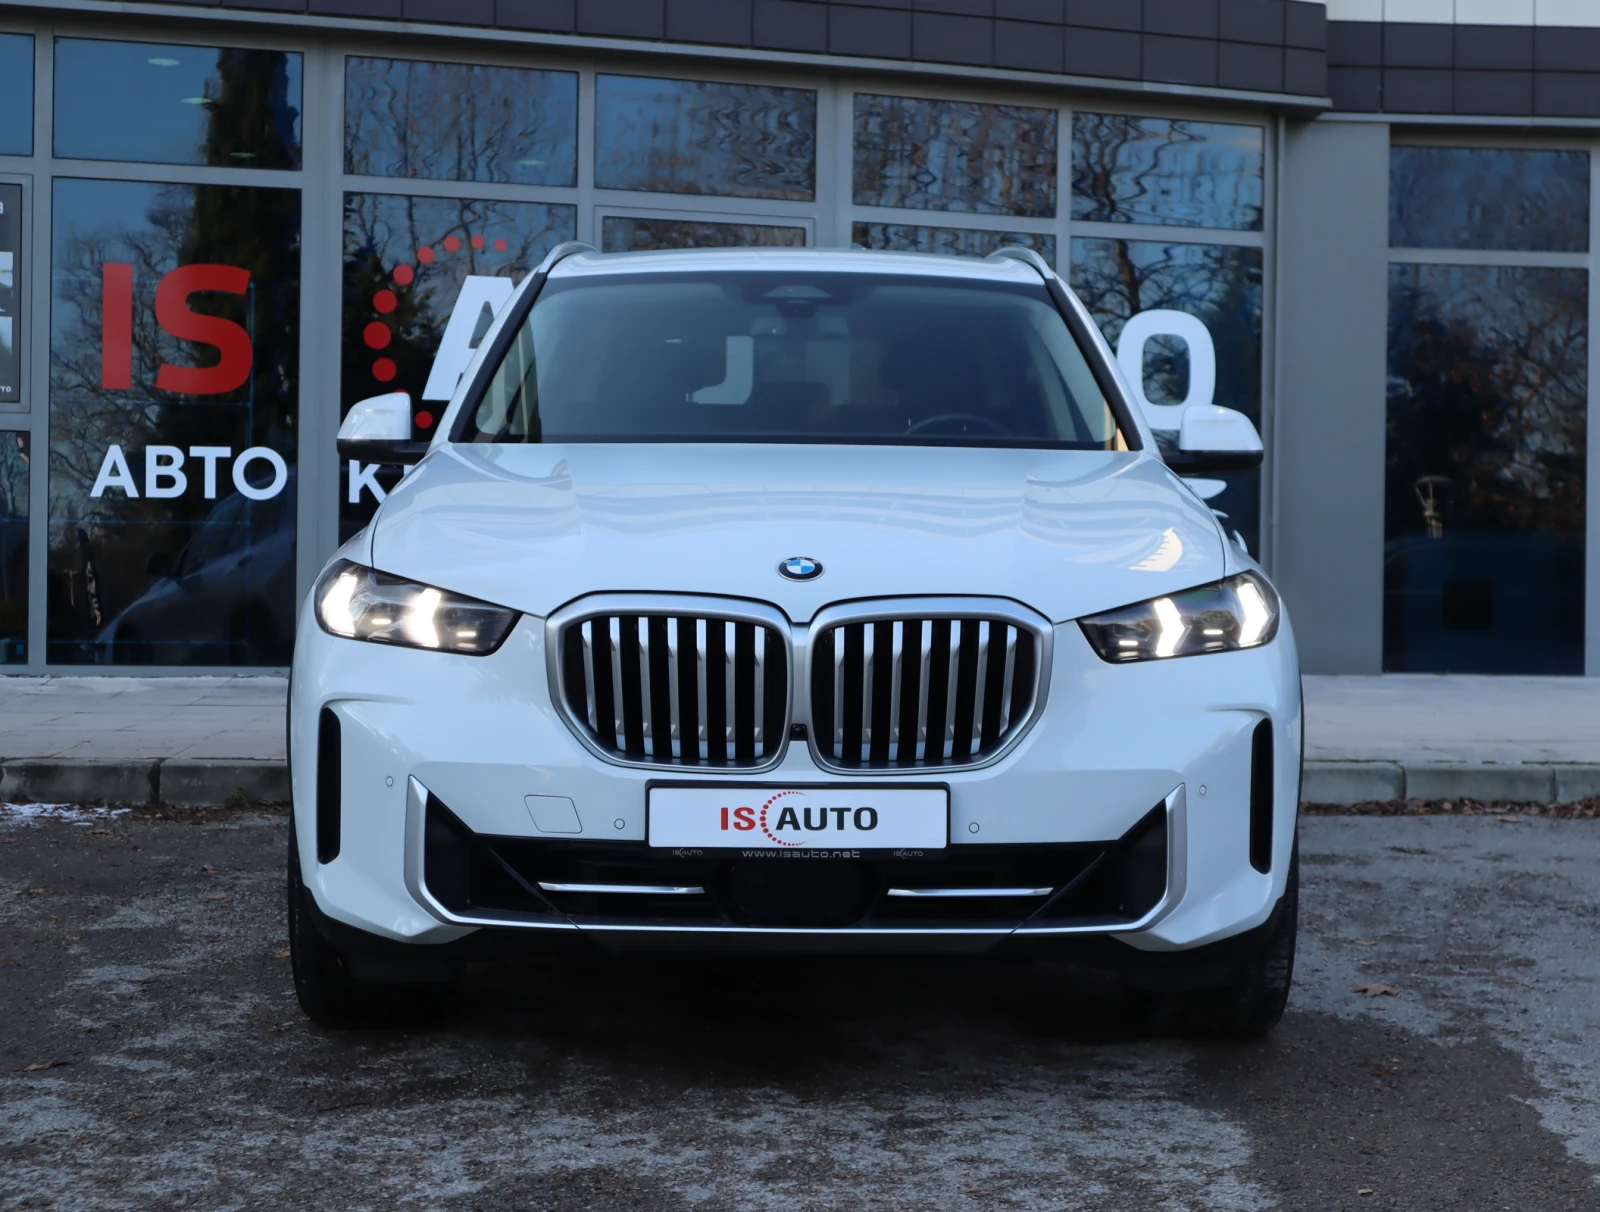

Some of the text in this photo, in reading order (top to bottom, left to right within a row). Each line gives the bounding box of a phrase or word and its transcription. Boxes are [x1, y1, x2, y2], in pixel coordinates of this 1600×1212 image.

[101, 262, 253, 394] IS
[90, 444, 288, 501] АВТО
[720, 806, 878, 831] IS AUTO
[742, 849, 861, 858] www.isauto.net
